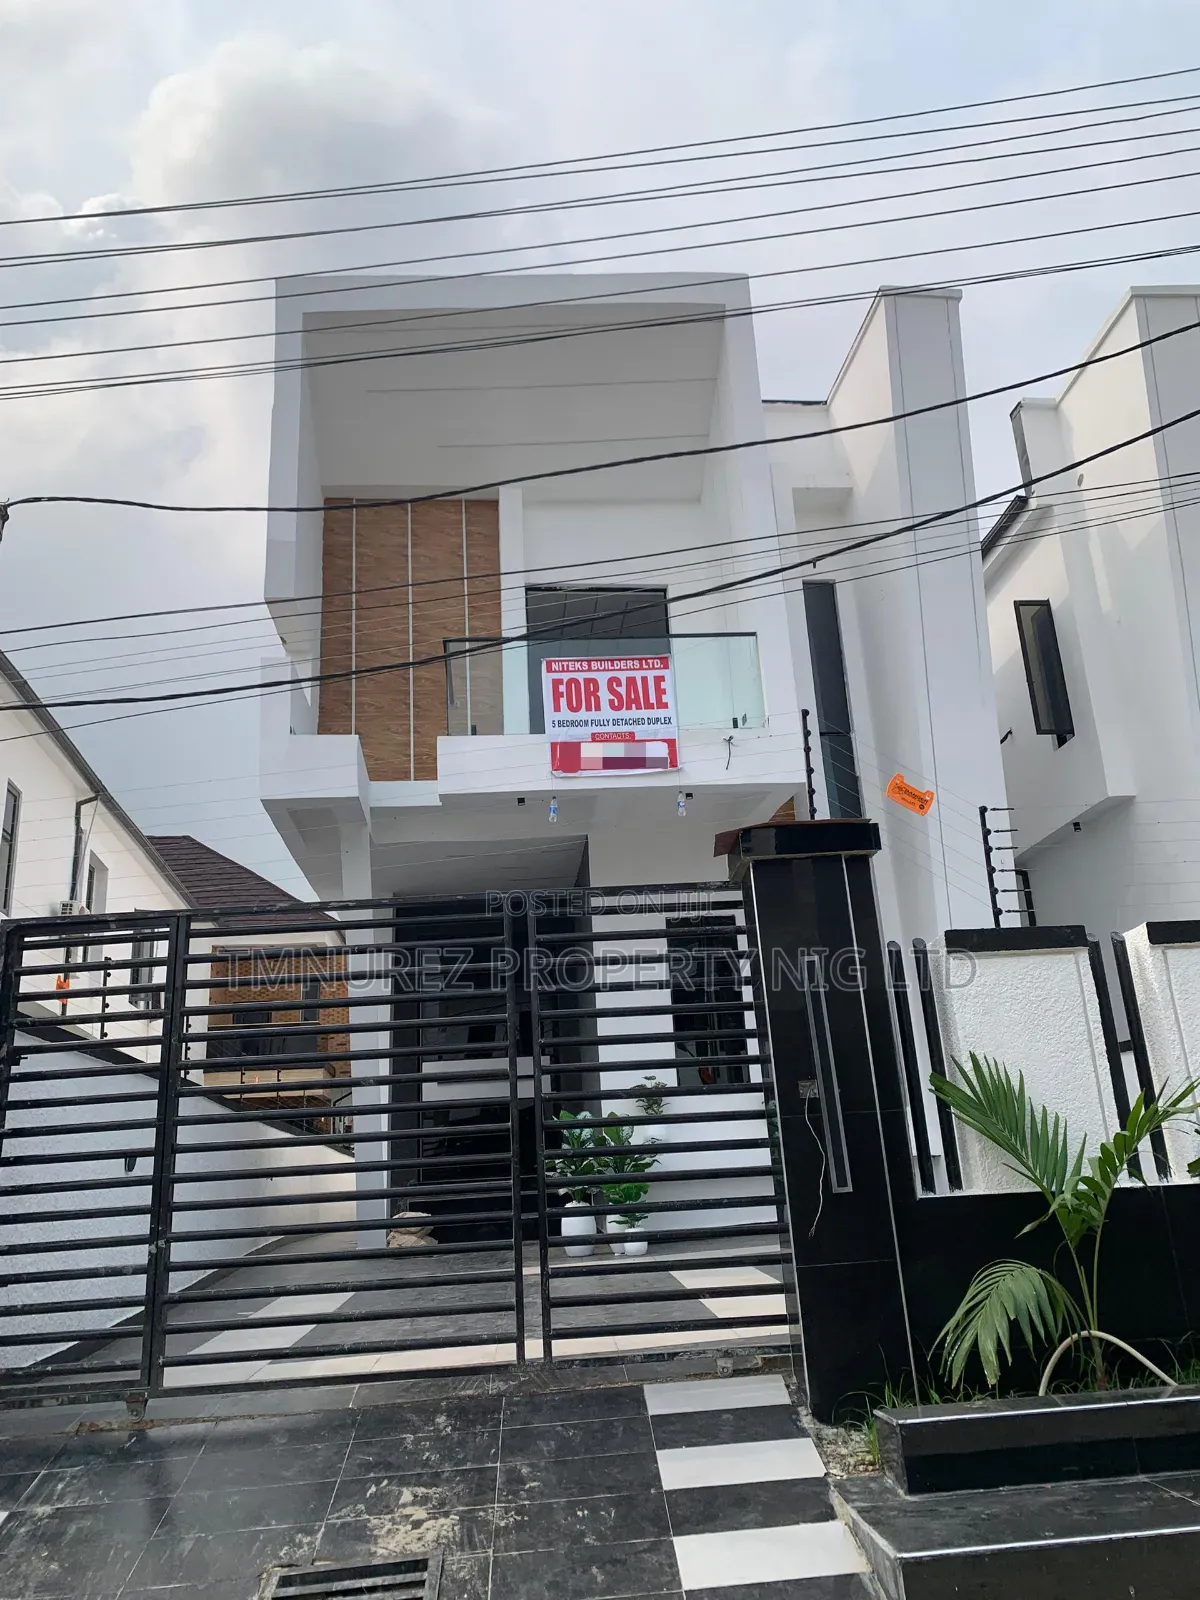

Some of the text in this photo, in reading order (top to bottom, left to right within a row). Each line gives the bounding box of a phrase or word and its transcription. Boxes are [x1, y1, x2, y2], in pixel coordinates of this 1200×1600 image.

[552, 659, 663, 671] NITEKS BUILDERS LTD.
[552, 675, 668, 713] FOR SALE
[552, 717, 672, 728] 5 BEDROOM FULLY DETACHED DUPLEX
